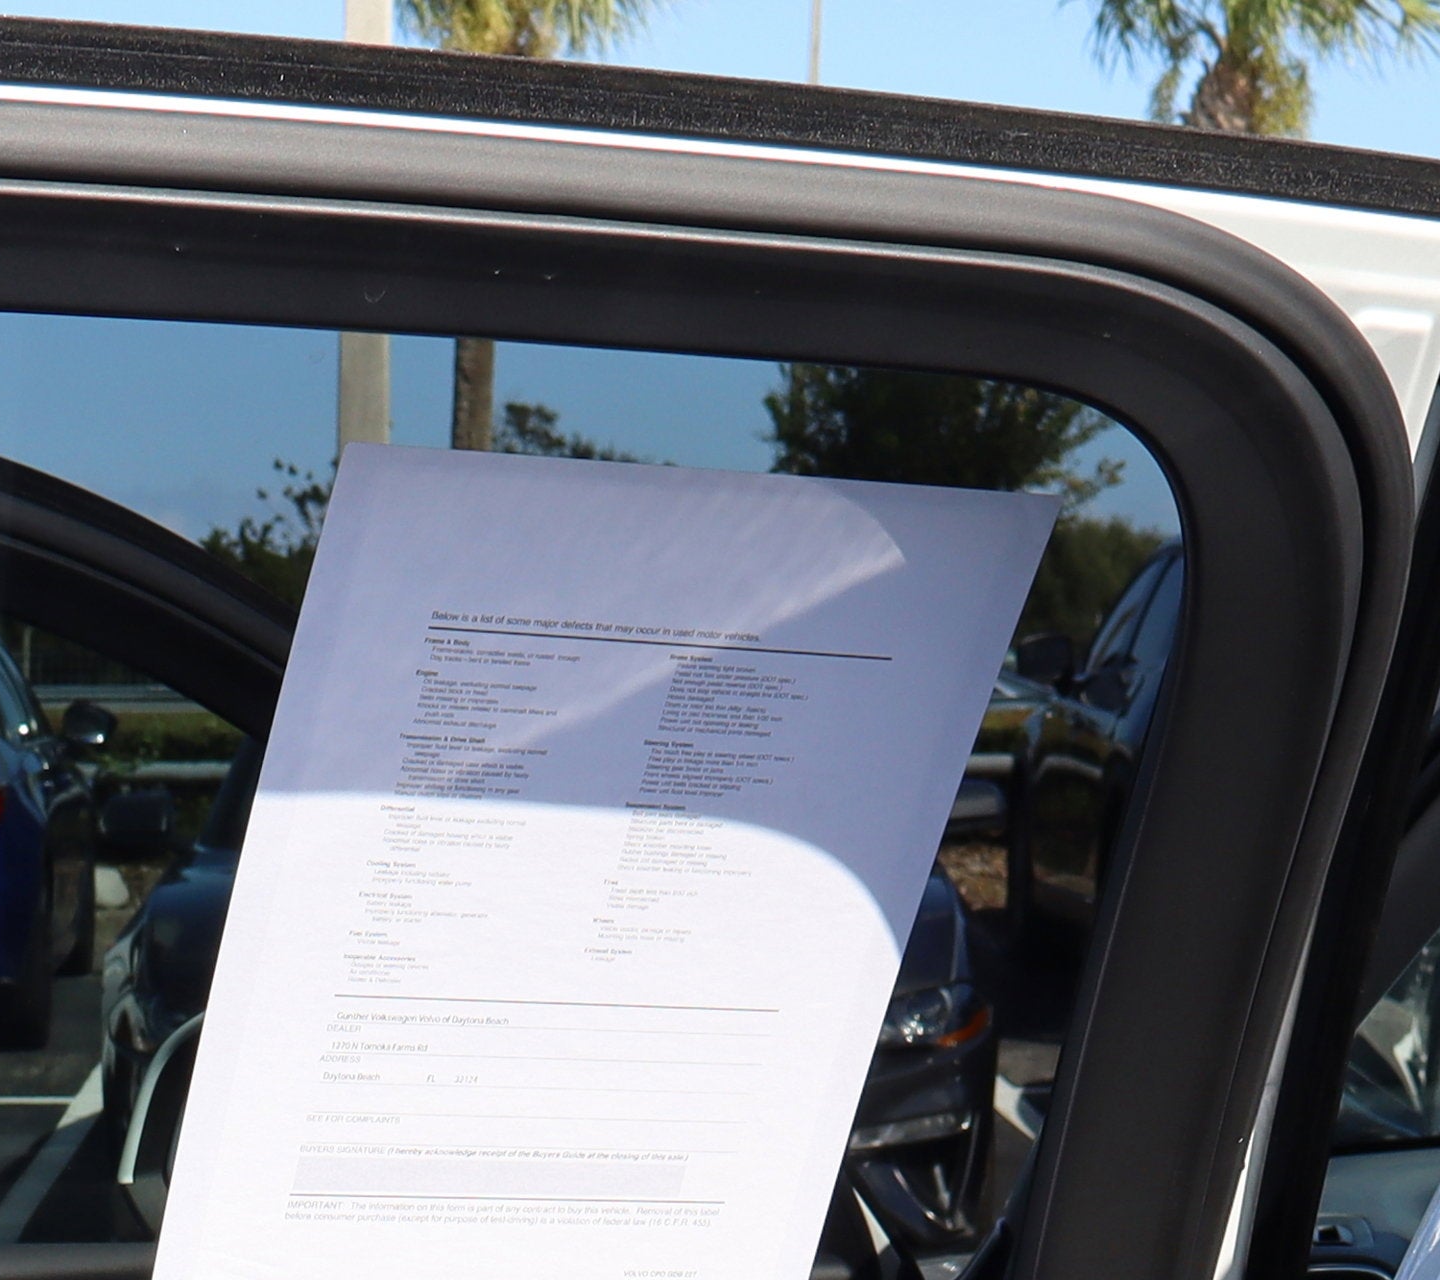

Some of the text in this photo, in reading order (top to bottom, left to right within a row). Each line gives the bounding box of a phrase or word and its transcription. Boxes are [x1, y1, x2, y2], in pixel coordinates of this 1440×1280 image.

[431, 611, 460, 621] Below
[479, 615, 494, 623] list
[505, 618, 531, 626] some
[532, 620, 559, 629] major
[560, 620, 594, 630] defects
[594, 623, 613, 631] that
[613, 626, 634, 635] may
[635, 627, 660, 635] occur
[672, 628, 695, 637] used
[696, 630, 721, 639] motor
